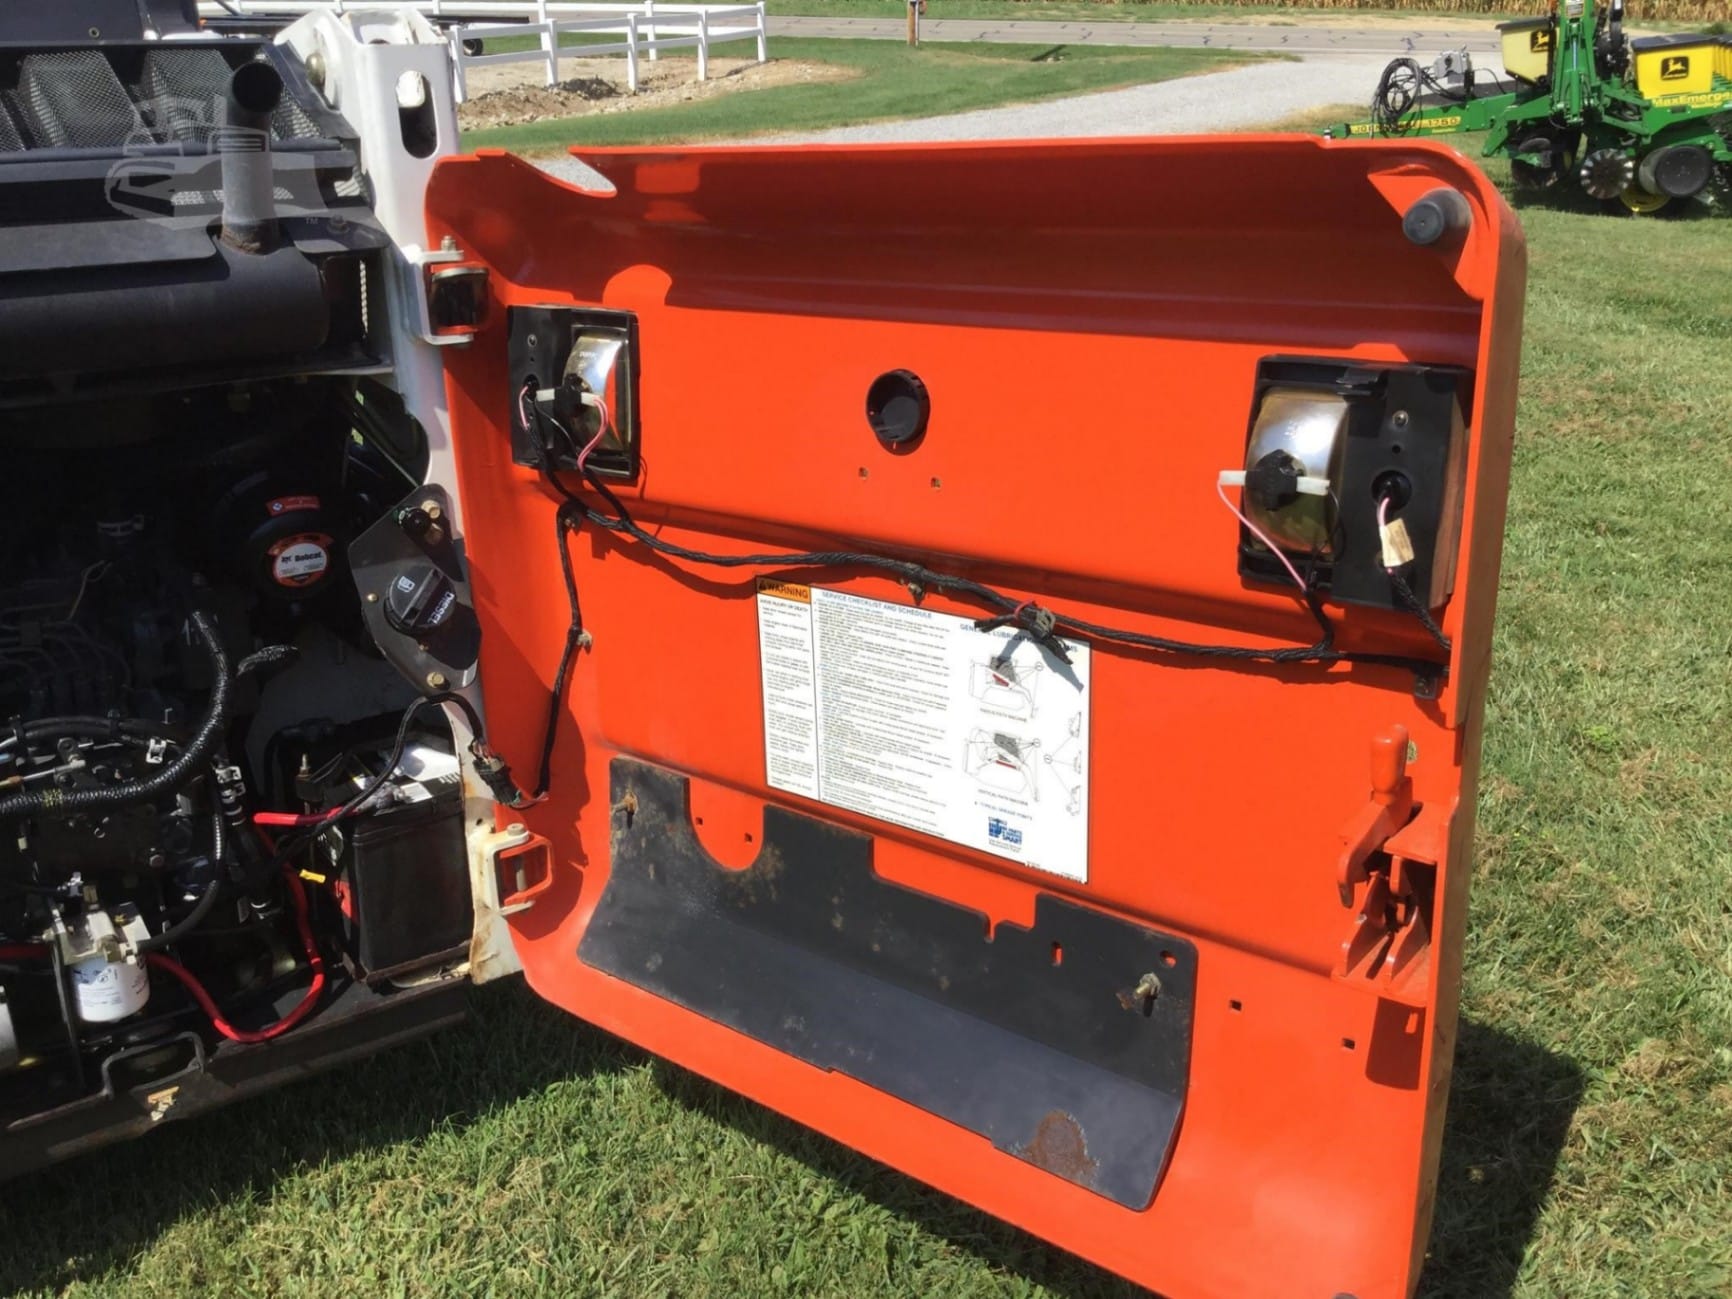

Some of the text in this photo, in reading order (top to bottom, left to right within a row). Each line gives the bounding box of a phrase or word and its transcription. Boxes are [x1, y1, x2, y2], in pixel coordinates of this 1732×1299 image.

[1427, 118, 1459, 127] 1750
[768, 583, 809, 599] WARNING
[427, 591, 455, 624] DIESEL
[822, 591, 932, 619] SERVICE CHECKLIST AND SCHEDULE
